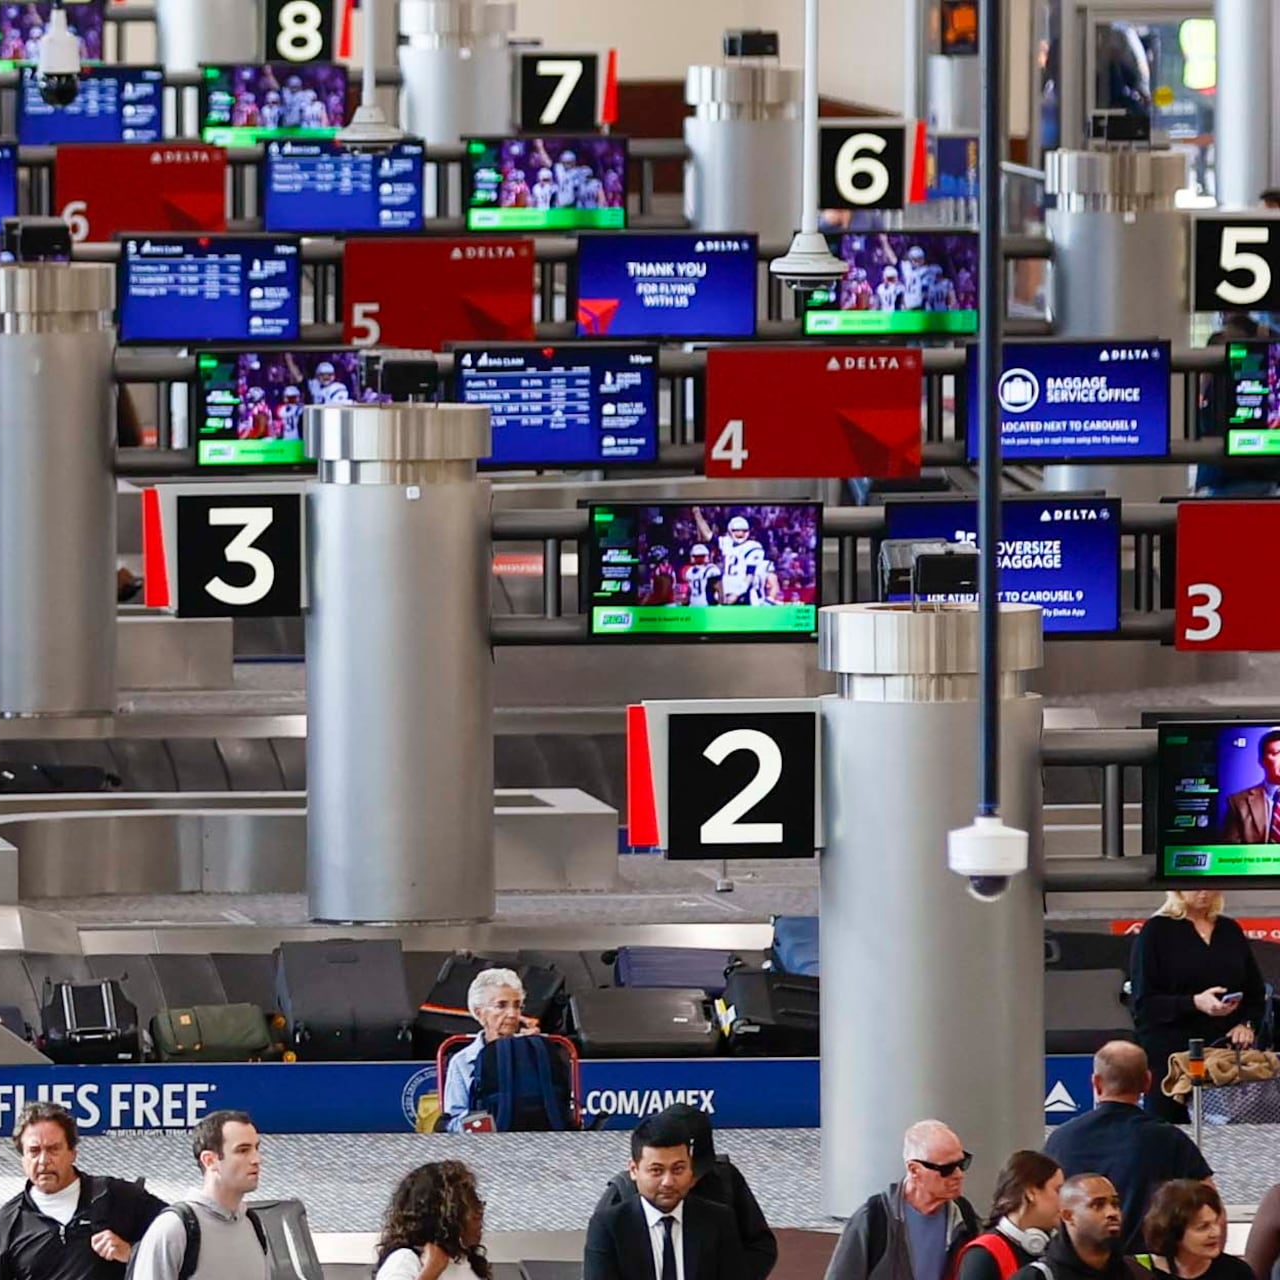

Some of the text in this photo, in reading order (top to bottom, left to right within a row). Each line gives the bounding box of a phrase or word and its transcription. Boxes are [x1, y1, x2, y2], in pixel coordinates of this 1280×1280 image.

[275, 1, 324, 62] 8
[535, 60, 583, 126] 7
[164, 152, 209, 163] DELTA
[834, 133, 890, 205] 6
[62, 200, 90, 241] 6
[466, 247, 516, 259] DELTA
[627, 262, 707, 278] THANK YOU
[1214, 226, 1271, 305] 5
[636, 282, 696, 296] FOR FLYING
[642, 295, 671, 307] WITH
[351, 303, 381, 348] 5
[1111, 349, 1149, 360] DELTA
[845, 356, 900, 370] DELTA
[1046, 376, 1107, 389] BAGGAGE
[1046, 387, 1140, 403] SERVICE OFFICE
[1001, 421, 1042, 433] LOCATED
[1083, 420, 1129, 432] CAROUSEL
[711, 419, 749, 470] 4
[1054, 509, 1098, 521] DELTA
[204, 507, 276, 606] 3
[1005, 591, 1020, 602] TO
[1021, 591, 1074, 602] CAROUSEL
[1075, 590, 1084, 601] 9
[1184, 584, 1223, 641] 3
[698, 728, 785, 845] 2
